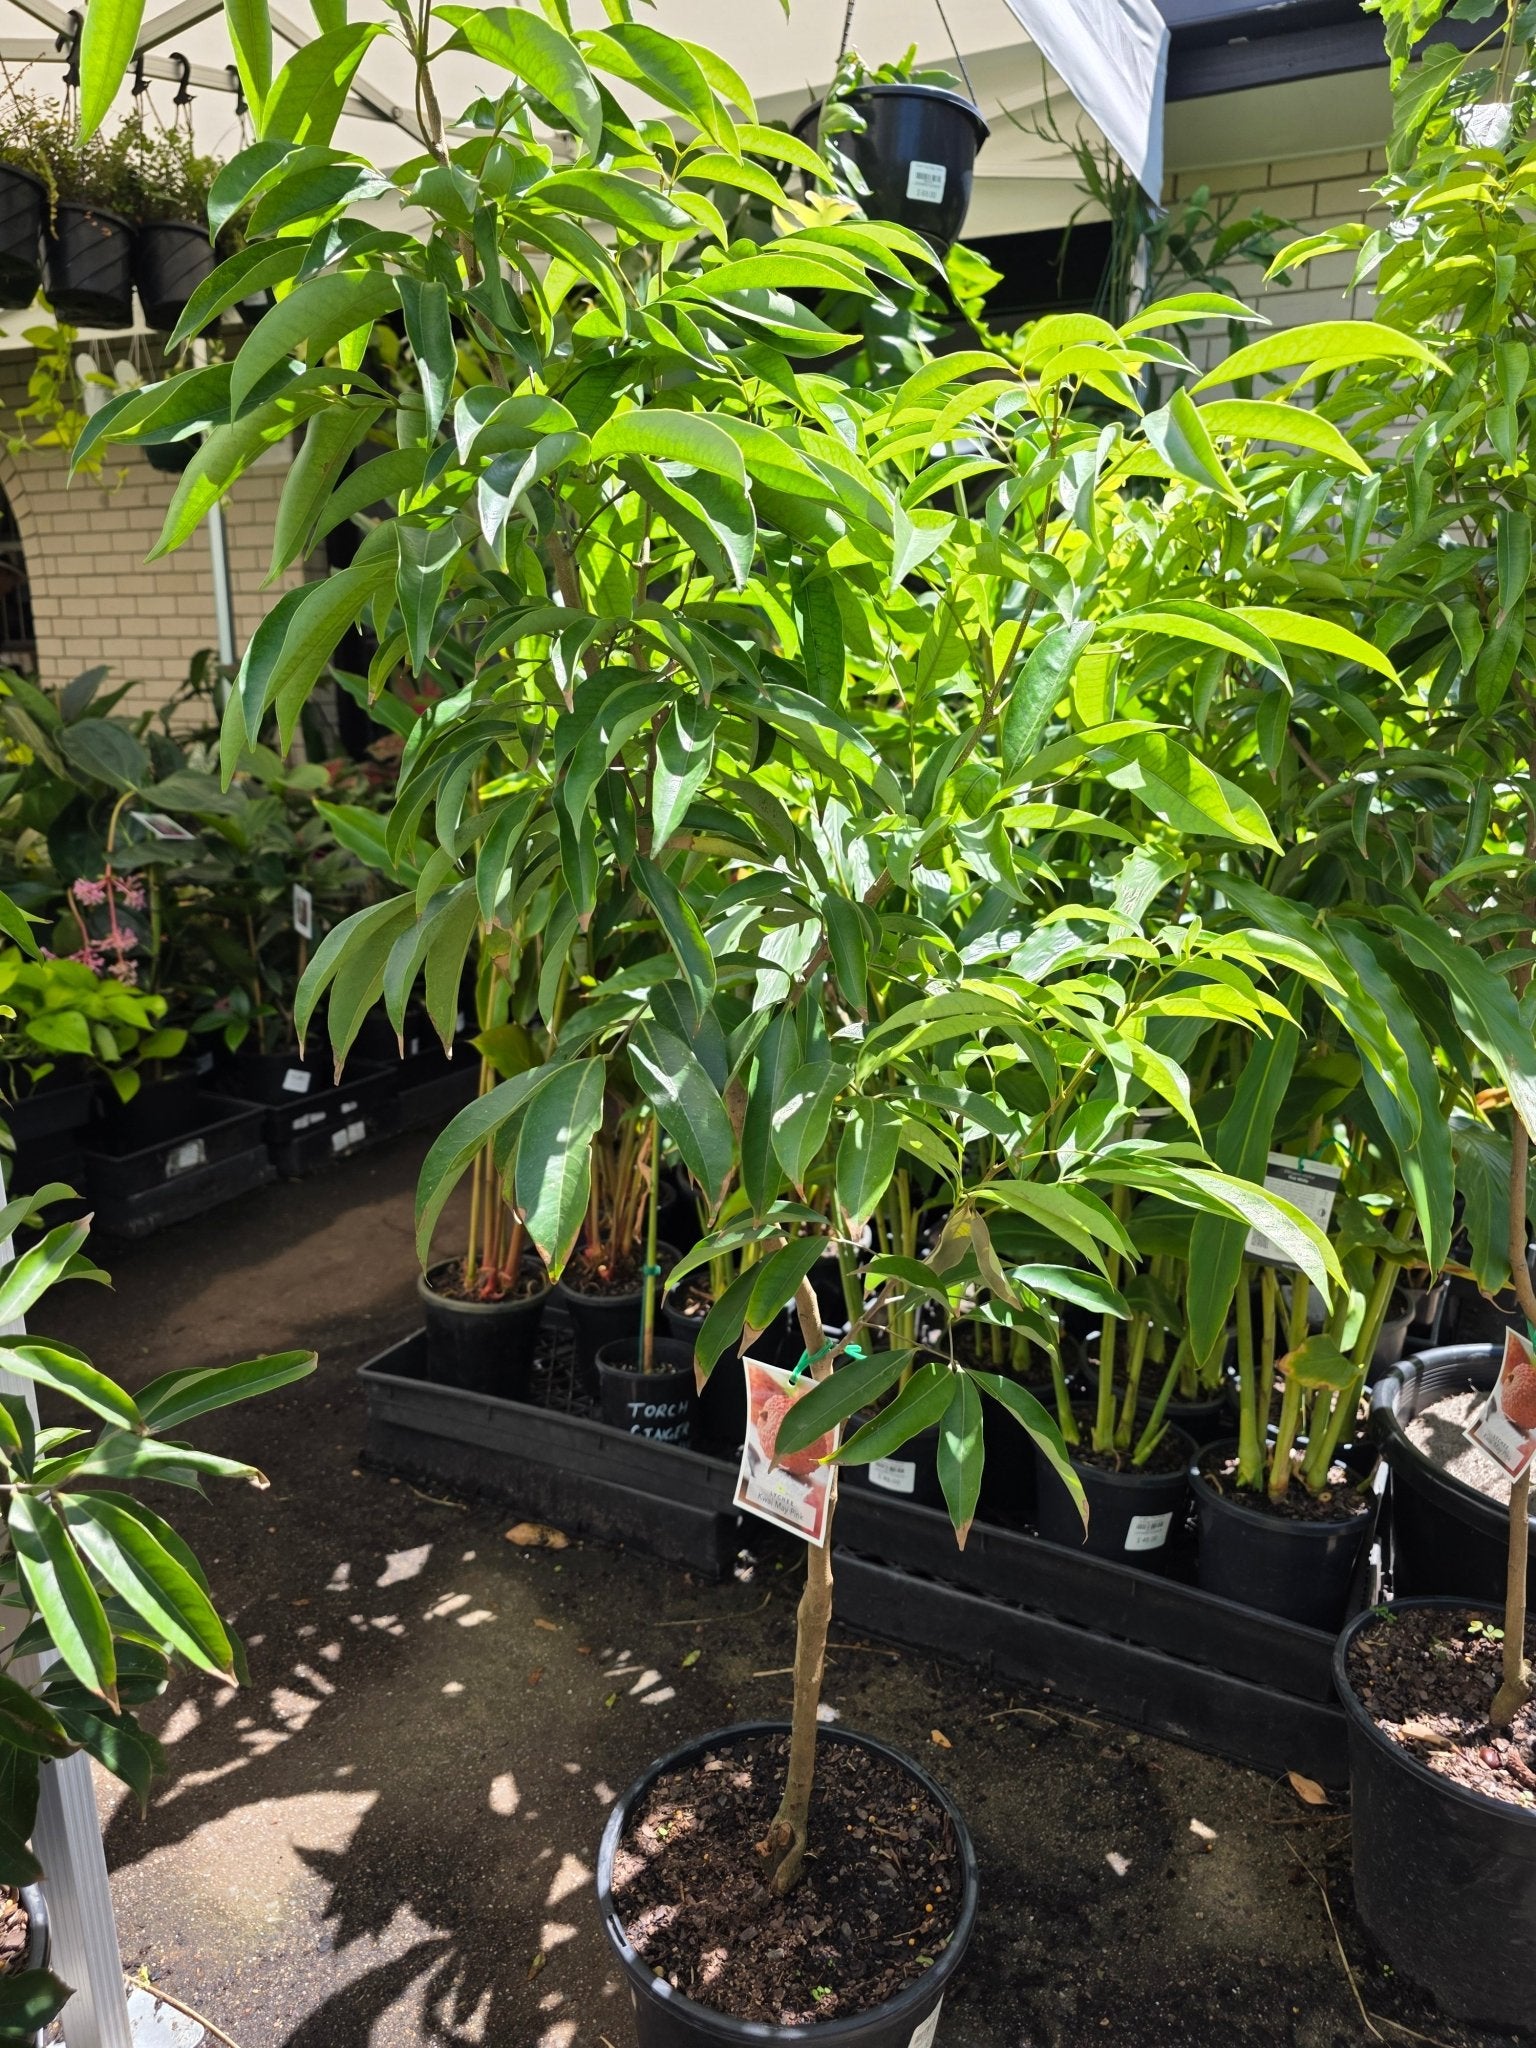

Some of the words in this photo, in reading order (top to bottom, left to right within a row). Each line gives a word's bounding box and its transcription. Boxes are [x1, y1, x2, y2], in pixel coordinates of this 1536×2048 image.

[627, 1402, 689, 1418] TORCH
[769, 1491, 795, 1506] LYCHEE
[774, 1500, 789, 1513] May
